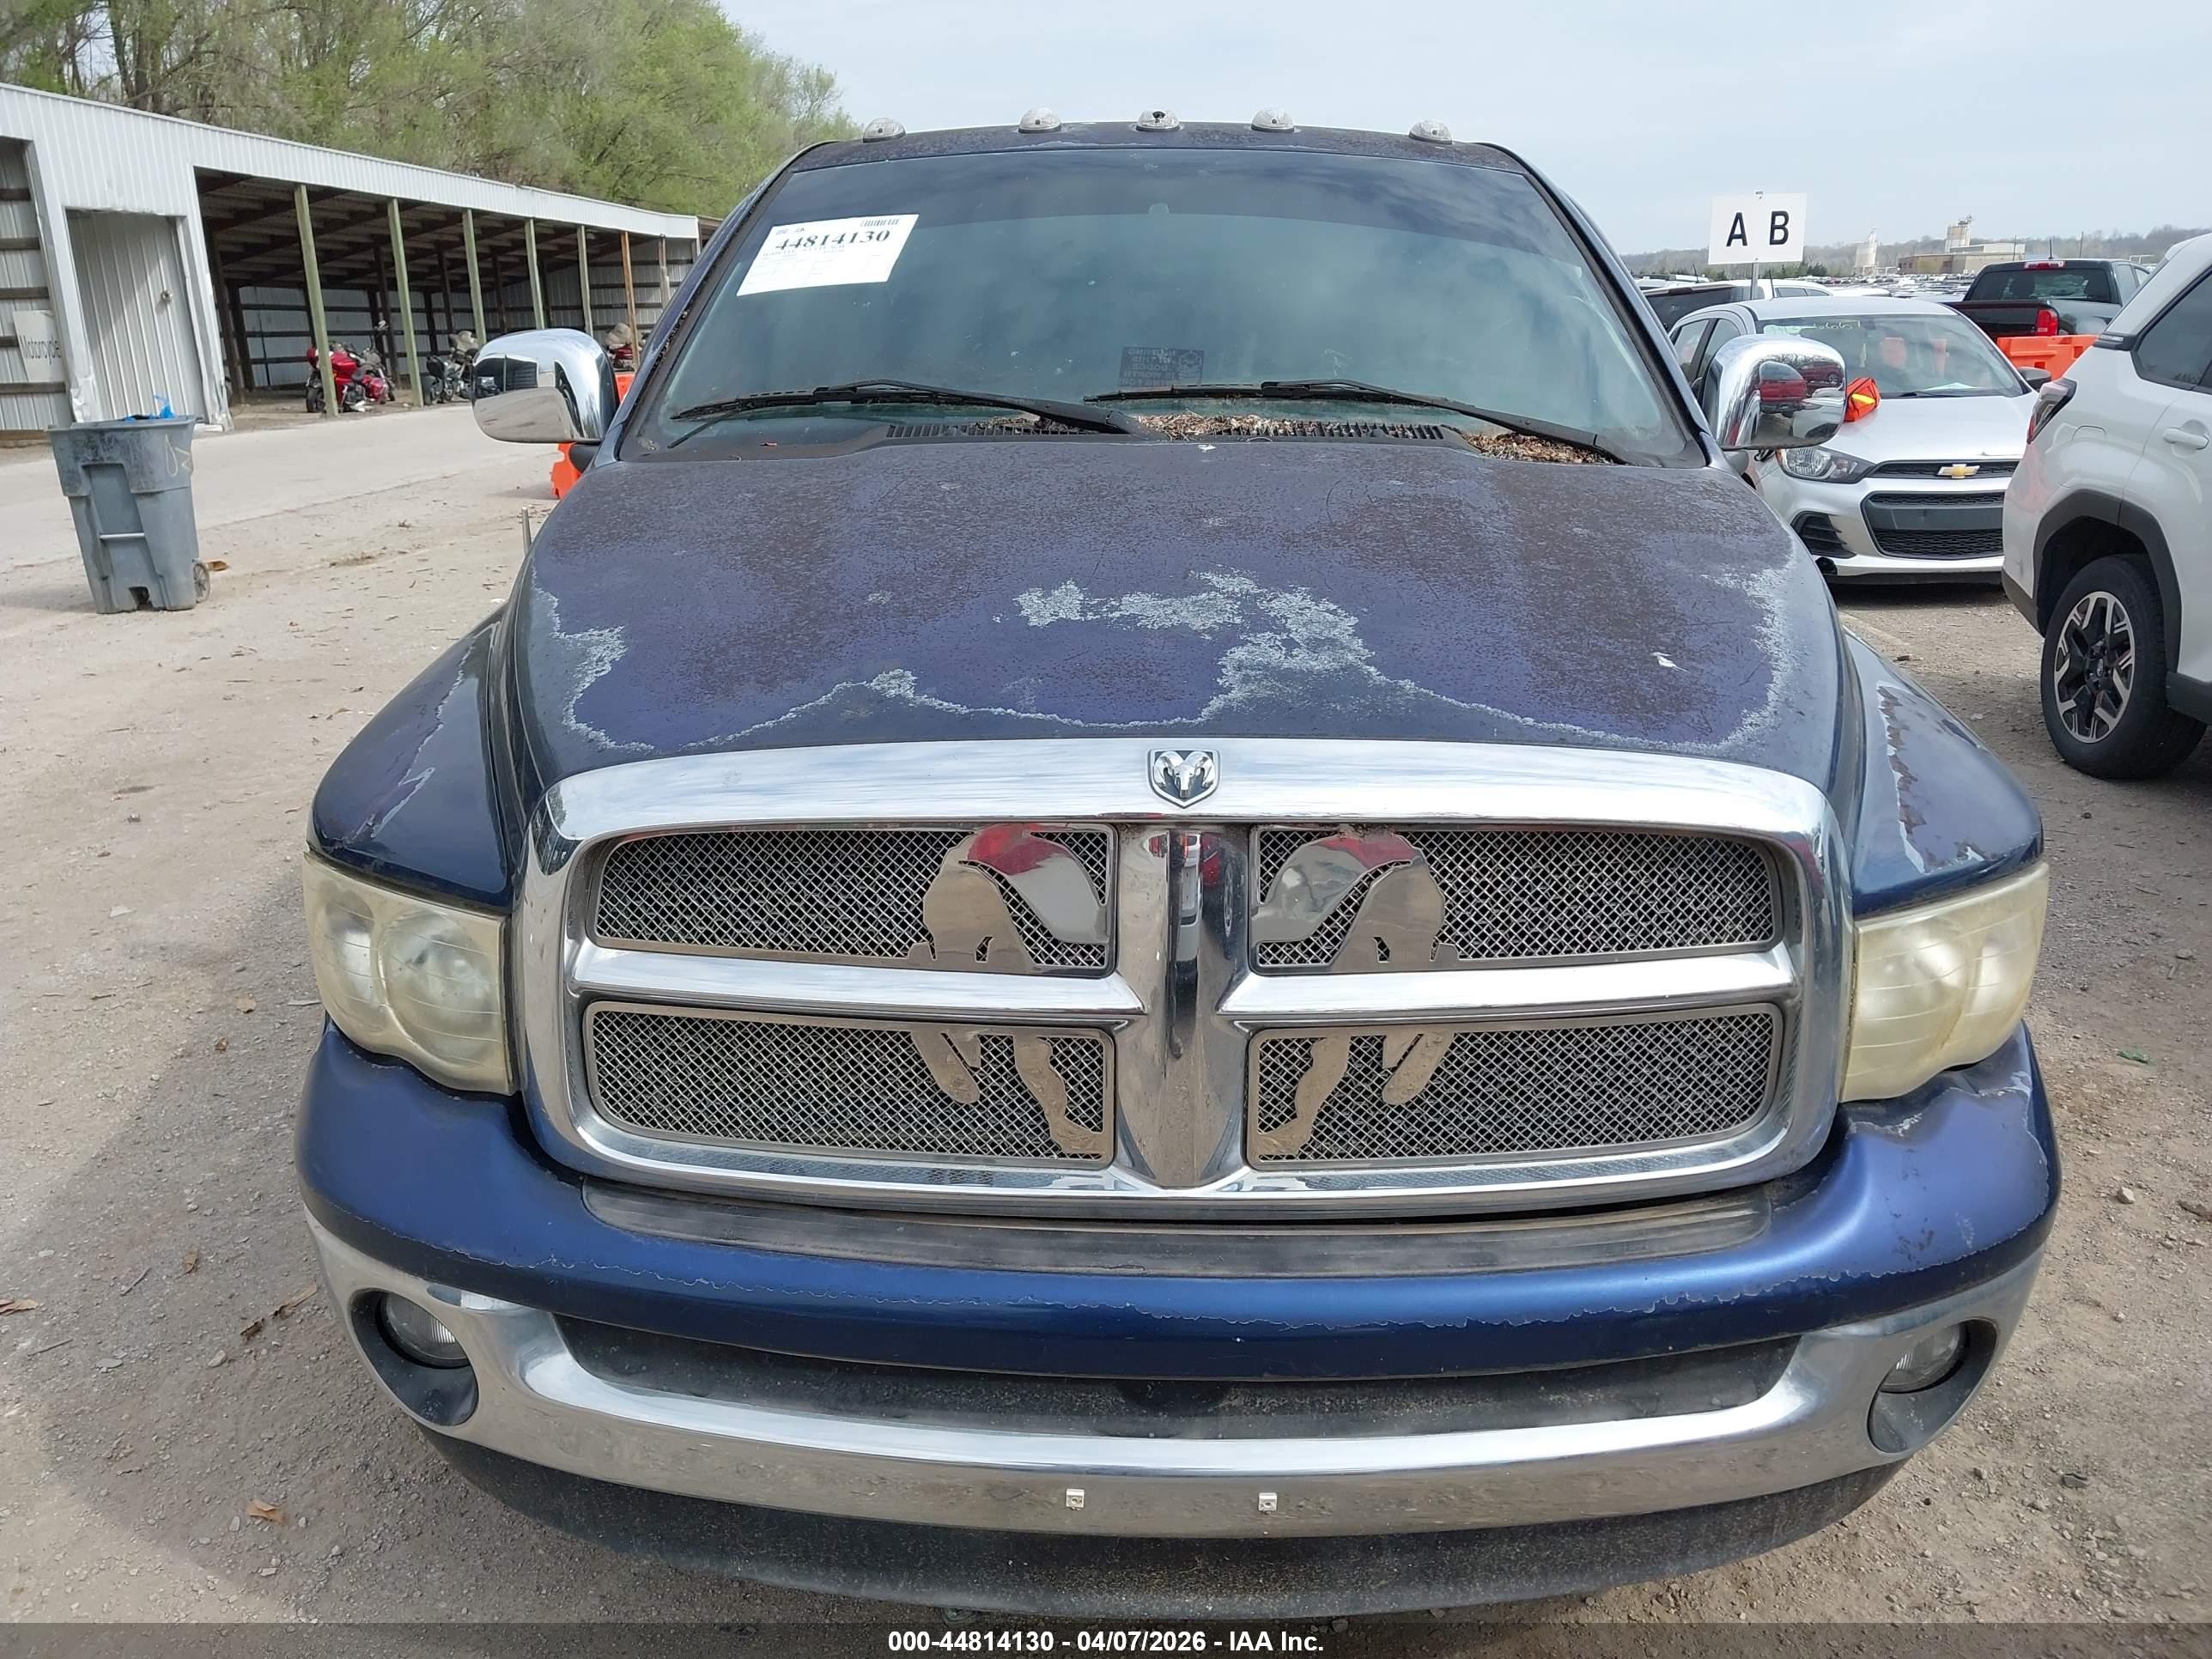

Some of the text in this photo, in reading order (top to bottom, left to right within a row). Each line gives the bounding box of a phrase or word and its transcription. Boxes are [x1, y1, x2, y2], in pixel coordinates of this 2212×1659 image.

[775, 229, 890, 250] 44814130
[1725, 210, 1790, 247] A B
